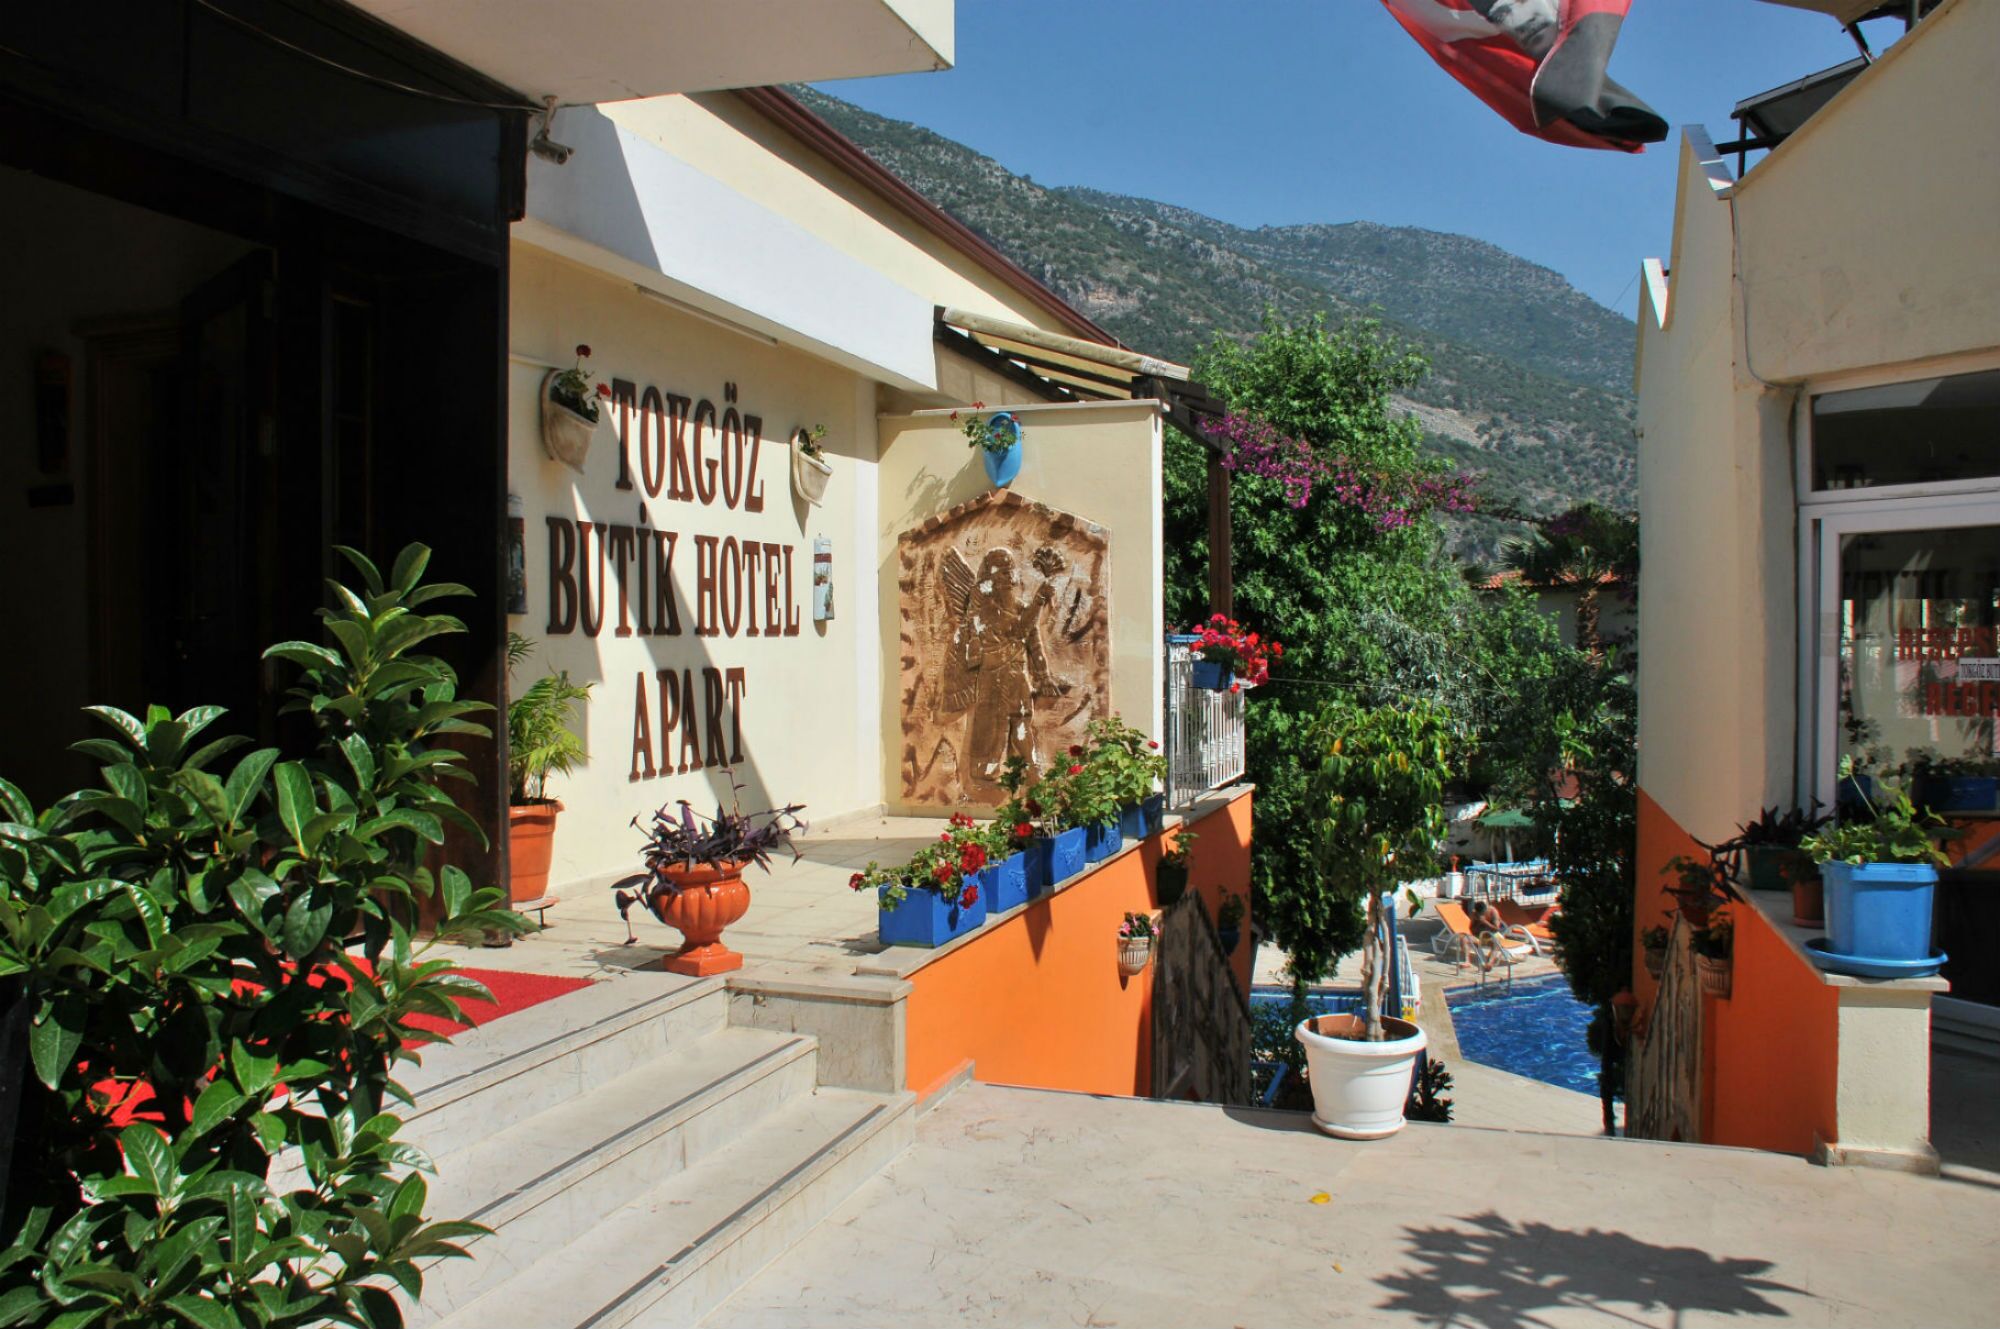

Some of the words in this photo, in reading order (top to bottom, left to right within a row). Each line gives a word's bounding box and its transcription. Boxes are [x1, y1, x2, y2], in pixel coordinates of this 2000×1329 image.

[612, 379, 764, 512] TOKGÖZ
[546, 503, 682, 637] BUTİK
[694, 535, 799, 637] HOTEL
[629, 667, 745, 782] APART
